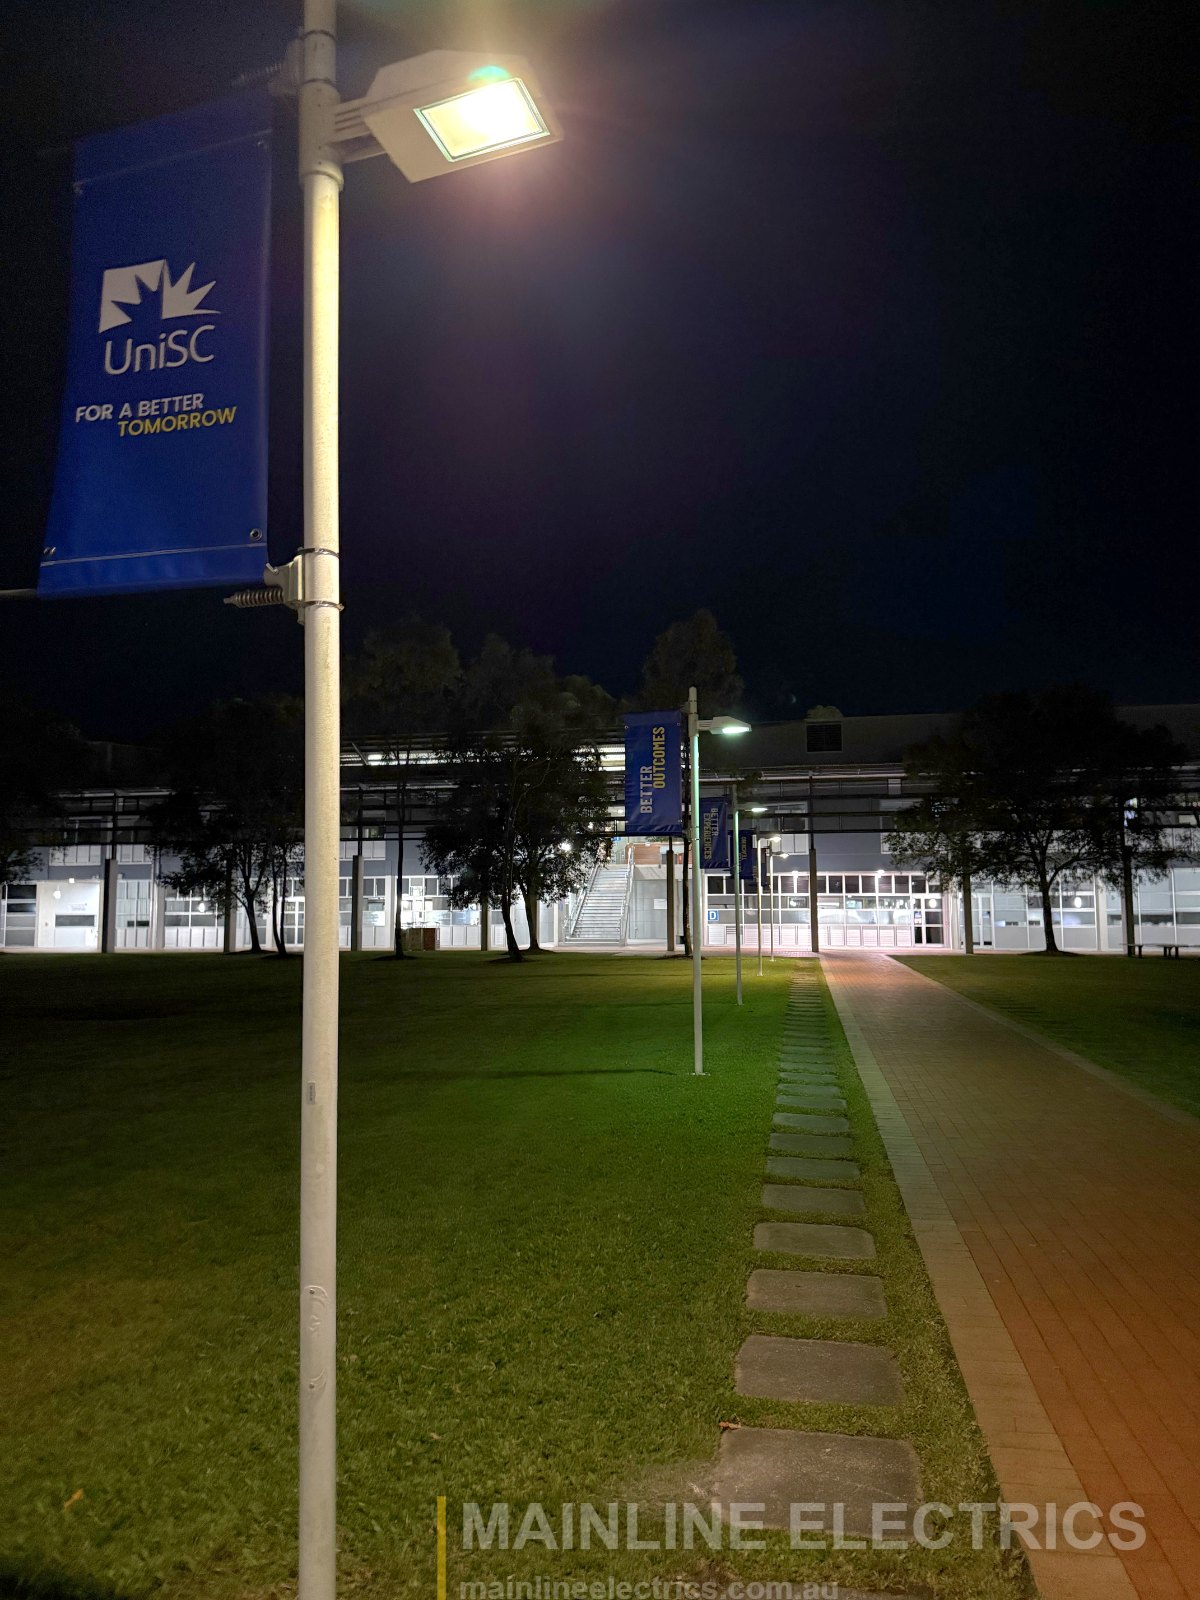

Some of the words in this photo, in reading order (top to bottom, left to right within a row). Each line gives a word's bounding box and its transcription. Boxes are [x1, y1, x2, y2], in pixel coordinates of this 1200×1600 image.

[104, 324, 216, 375] UniSC
[75, 403, 114, 423] FOR
[118, 402, 133, 419] A
[137, 393, 205, 417] BETTER
[117, 406, 238, 438] TOMORROW
[652, 726, 666, 789] OUTCOMES
[640, 765, 653, 814] BETTER
[710, 807, 719, 837] BETTER
[709, 911, 717, 920] D
